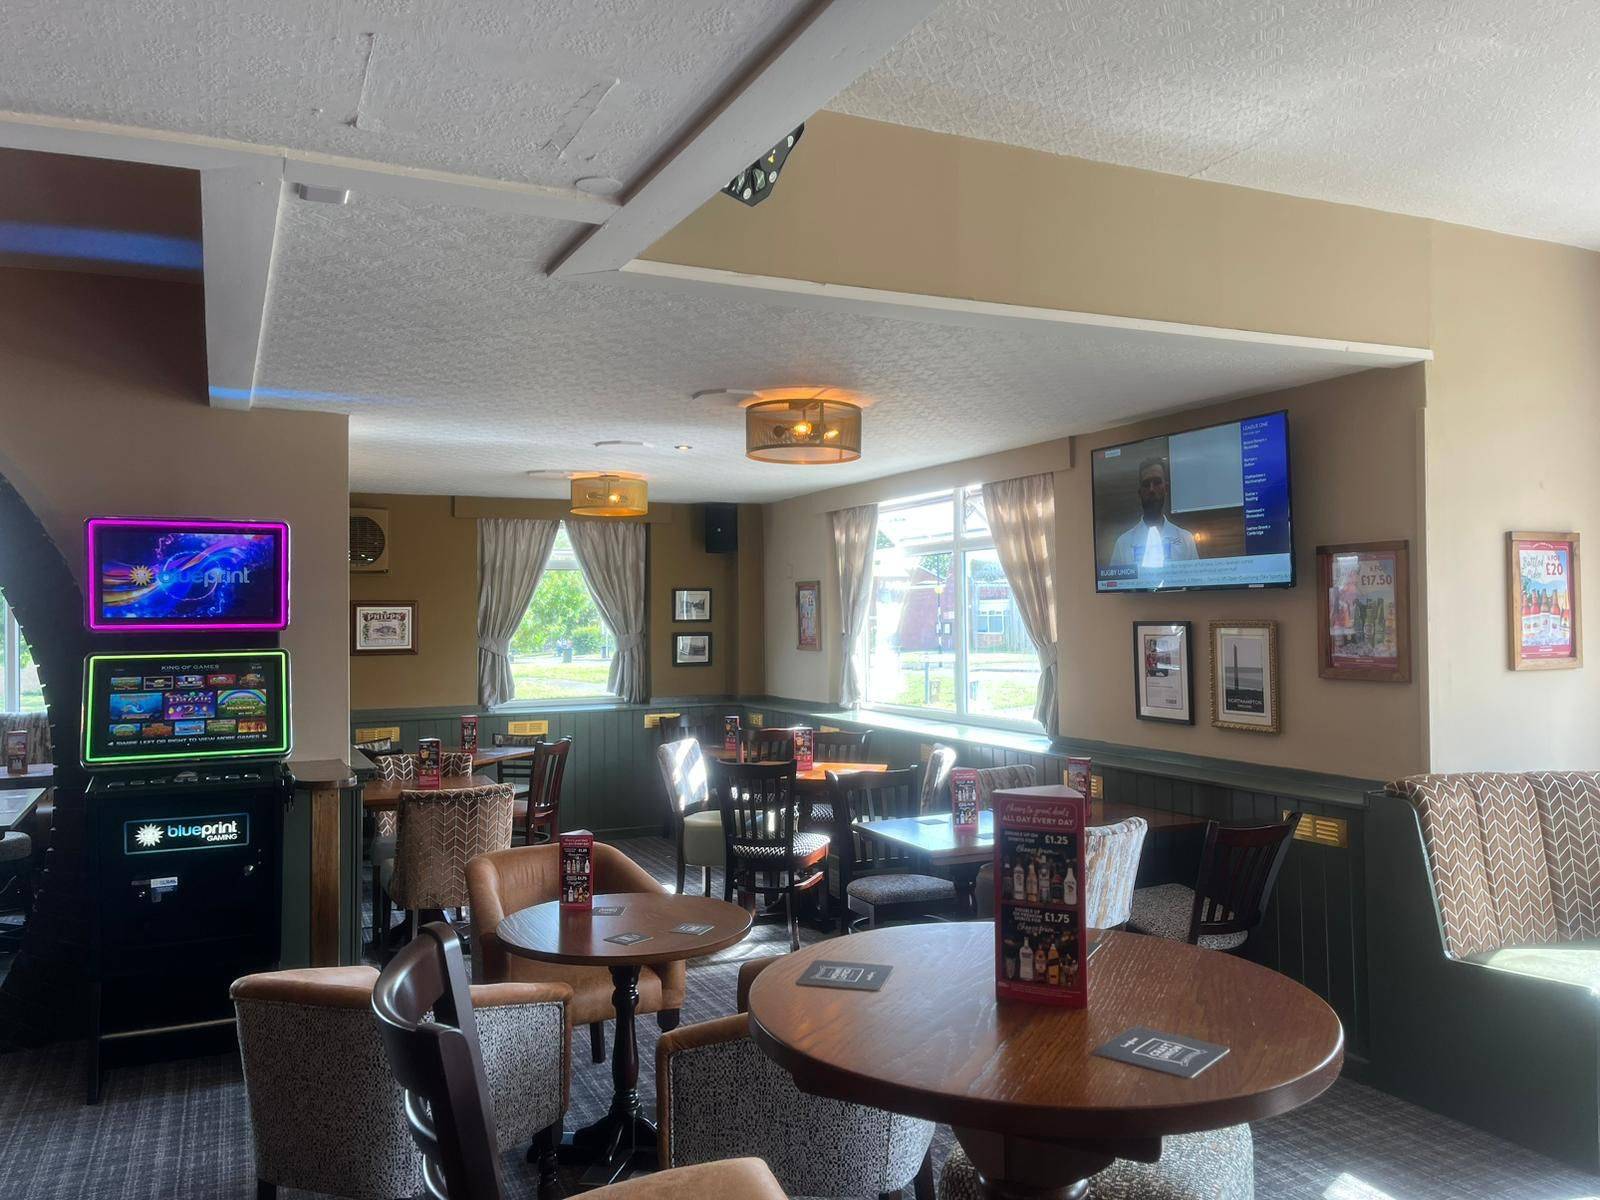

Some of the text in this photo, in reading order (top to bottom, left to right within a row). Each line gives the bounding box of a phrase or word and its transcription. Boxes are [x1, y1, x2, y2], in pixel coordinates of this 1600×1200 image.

[1546, 562, 1564, 576] £20
[1361, 574, 1393, 586] £17.50
[1016, 815, 1031, 823] DAY
[1032, 817, 1056, 825] EVERY
[167, 820, 239, 838] blueprint
[206, 833, 239, 842] GAMING
[1044, 834, 1069, 845] £1.25
[1044, 912, 1070, 924] £1.75
